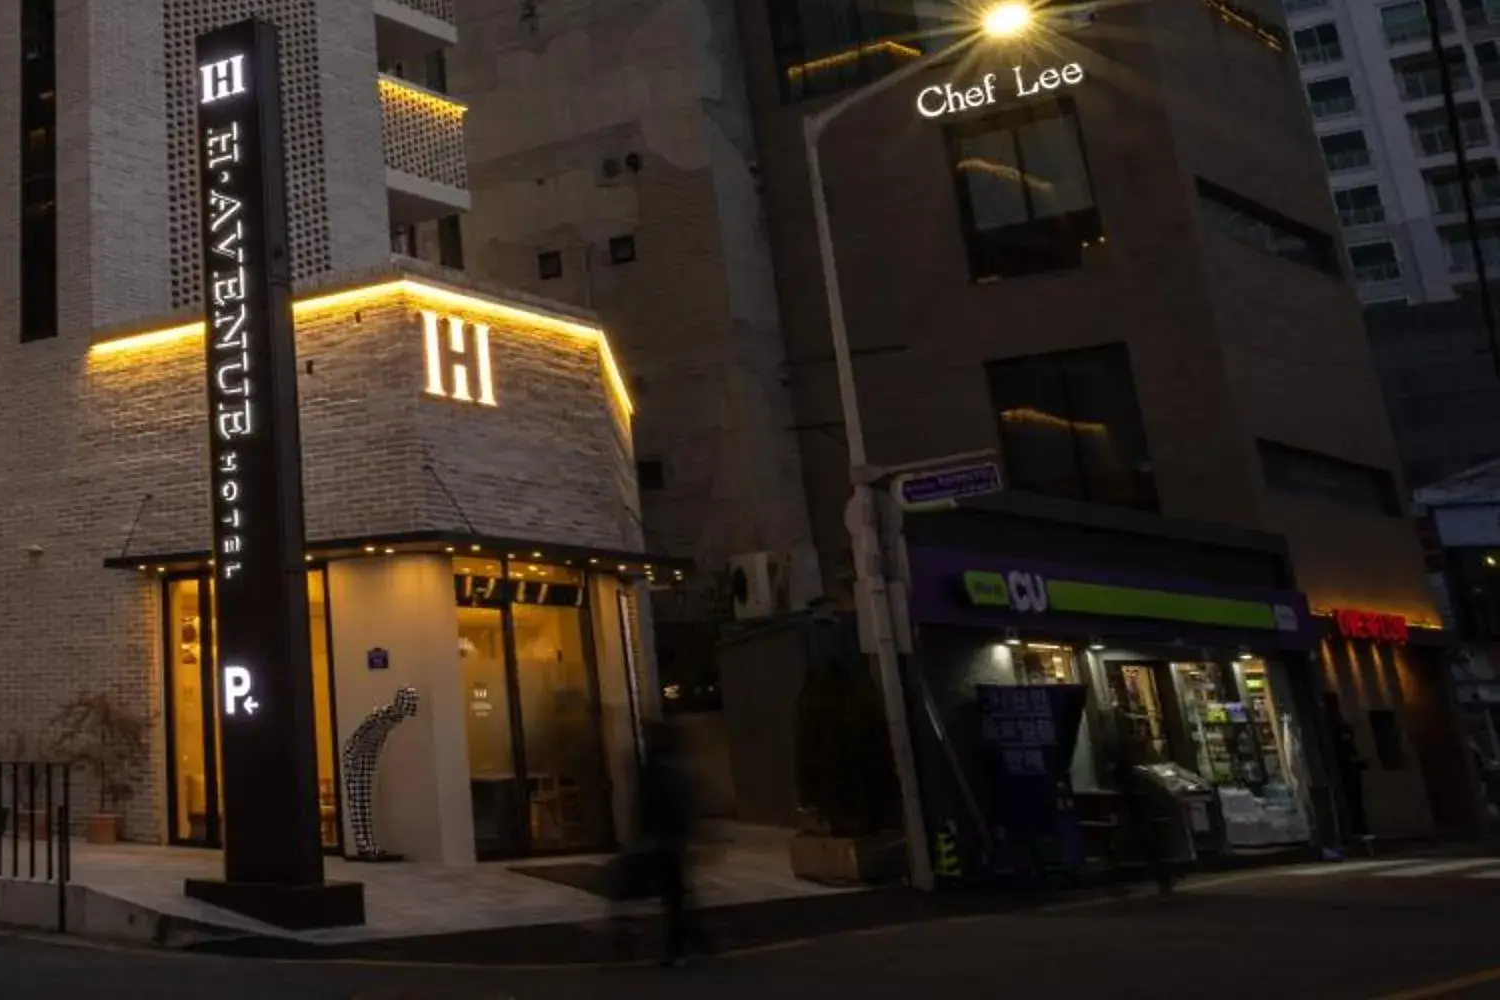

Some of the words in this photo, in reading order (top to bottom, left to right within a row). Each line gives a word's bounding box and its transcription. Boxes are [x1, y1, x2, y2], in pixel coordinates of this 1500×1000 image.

[916, 72, 997, 118] Chef
[1011, 61, 1084, 98] Lee
[219, 451, 242, 580] HOTEL
[1007, 569, 1049, 614] CU
[223, 665, 251, 715] P
